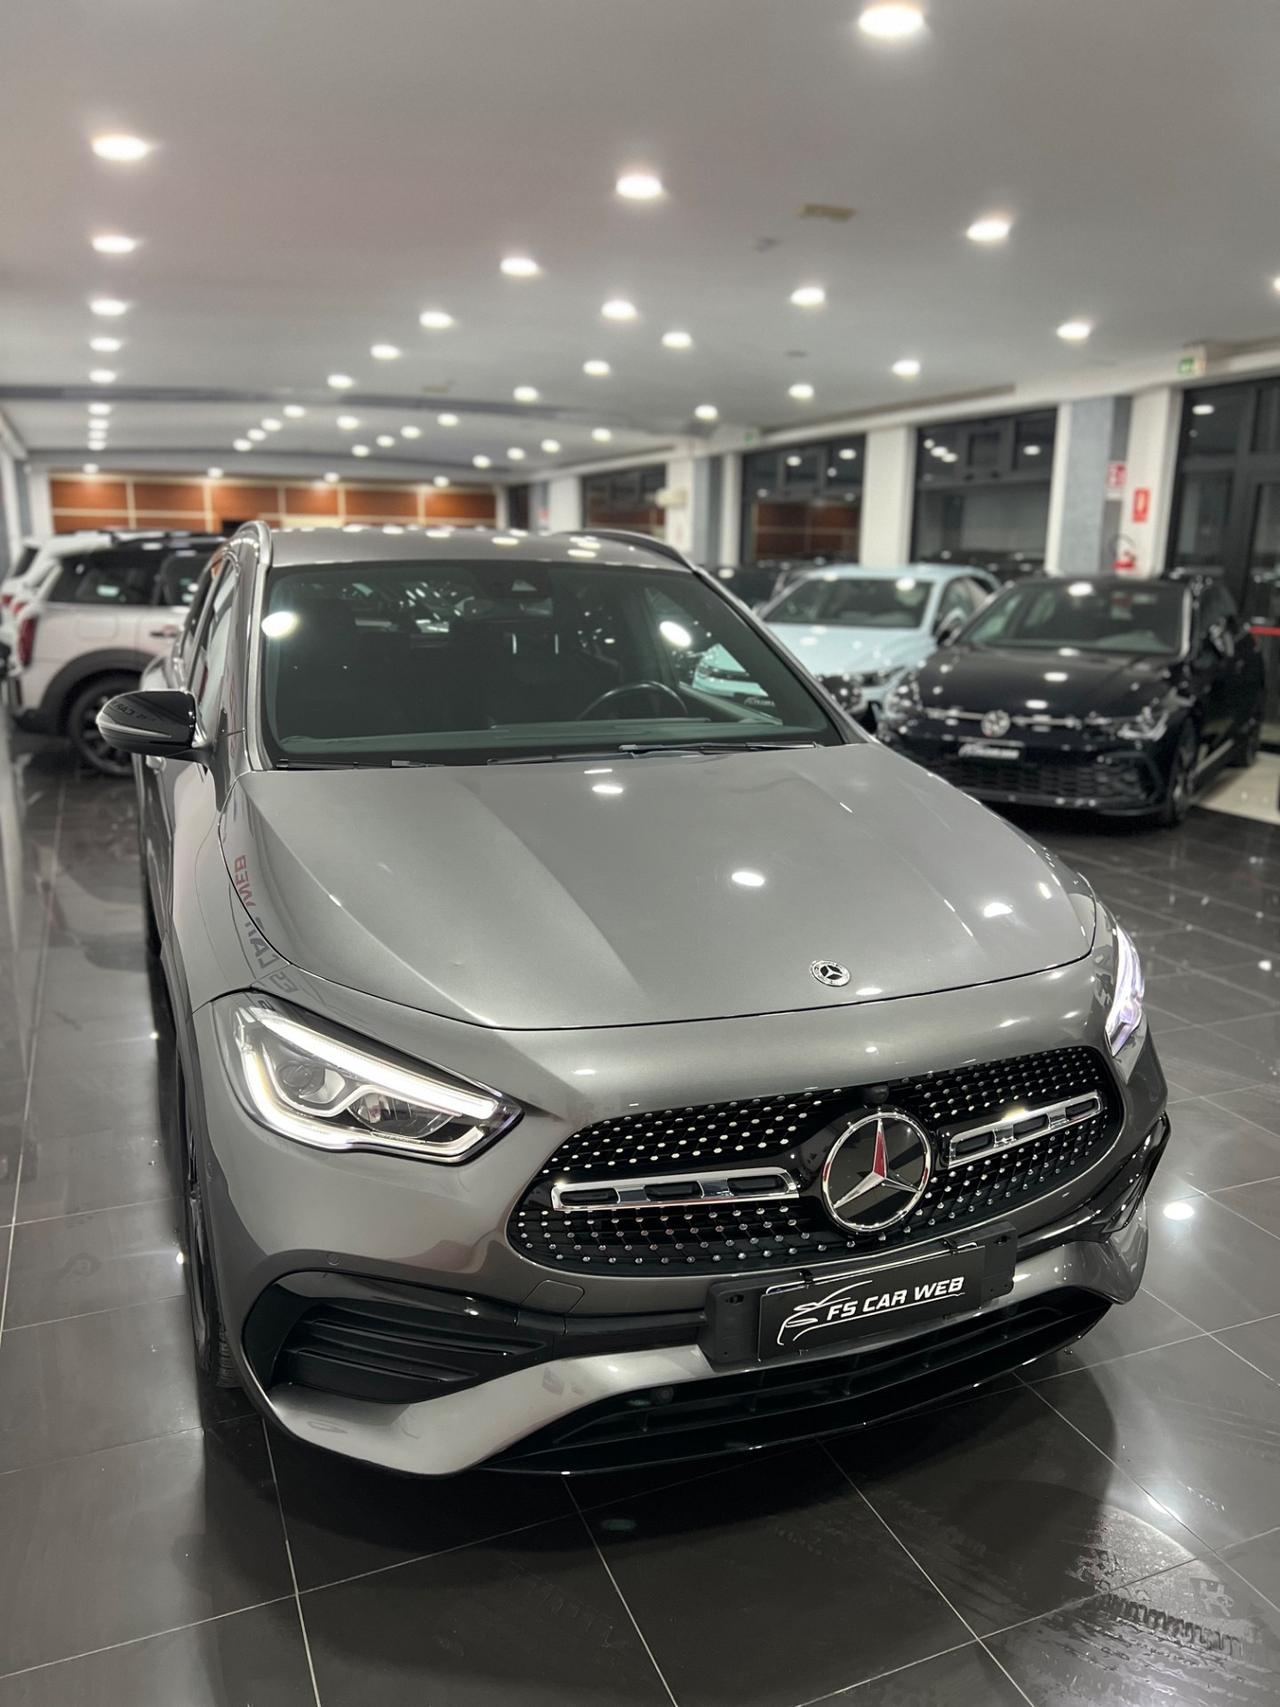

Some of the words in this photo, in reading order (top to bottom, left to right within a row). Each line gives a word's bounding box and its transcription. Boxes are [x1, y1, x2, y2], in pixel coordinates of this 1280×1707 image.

[826, 1300, 859, 1321] FS
[862, 1289, 908, 1313] CAR
[914, 1276, 965, 1301] WEB
